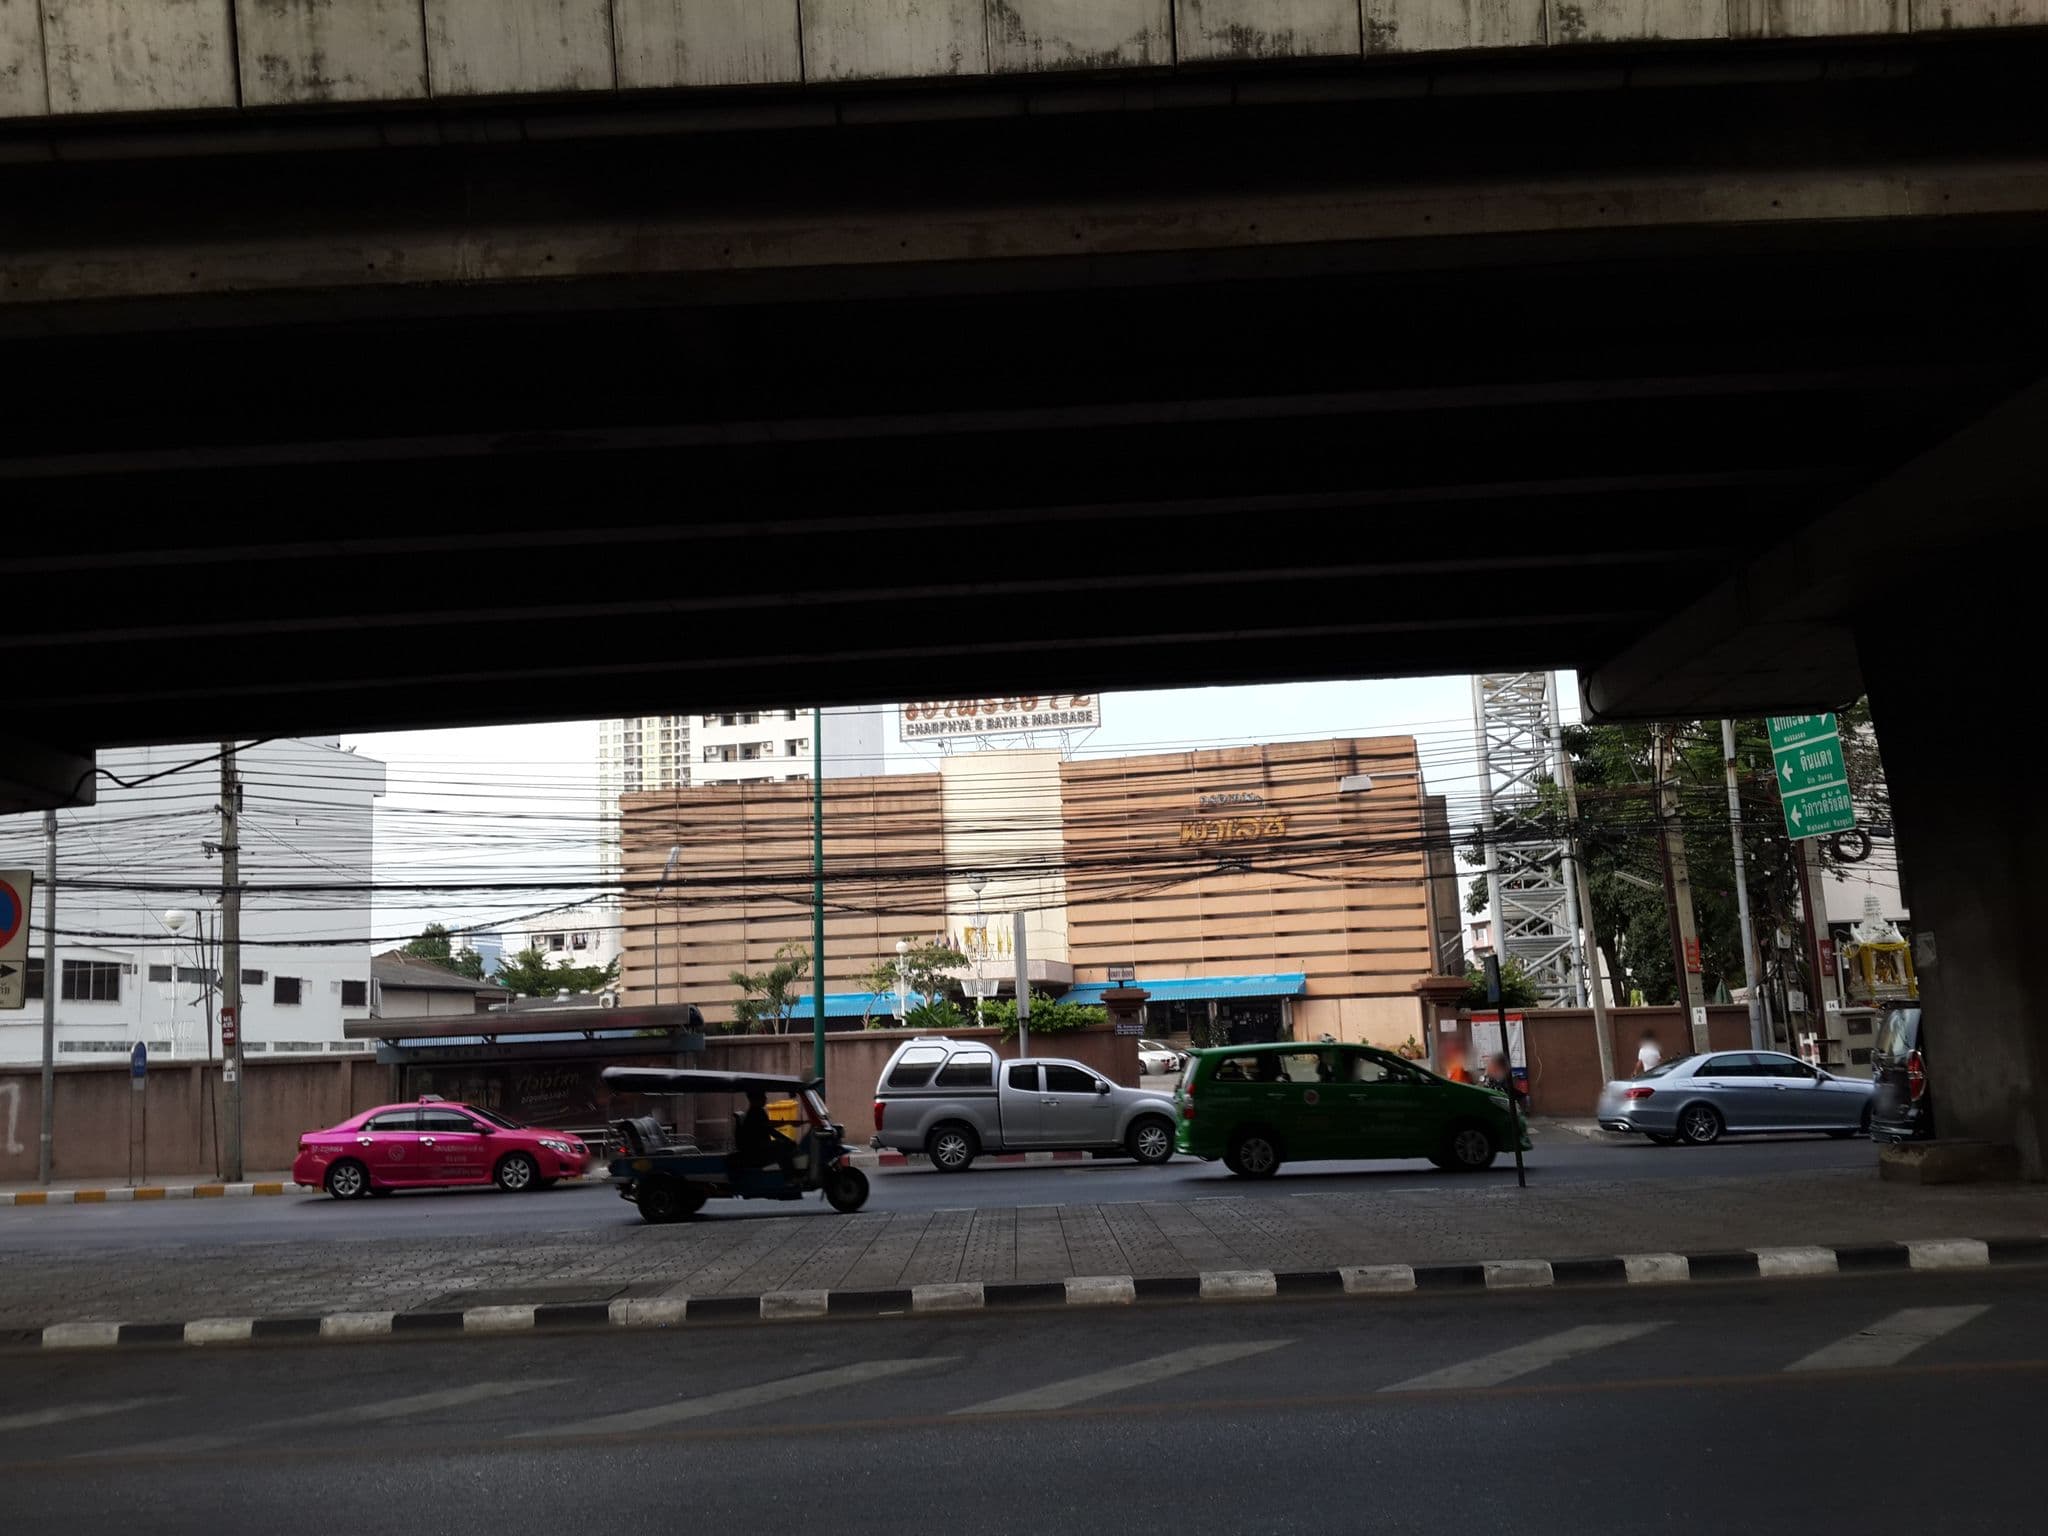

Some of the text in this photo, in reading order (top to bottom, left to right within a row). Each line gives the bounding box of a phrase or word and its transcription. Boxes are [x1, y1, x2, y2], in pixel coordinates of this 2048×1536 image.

[986, 715, 1017, 729] BATH
[1020, 715, 1028, 726] &
[1032, 710, 1093, 726] MASSAGE
[1799, 749, 1834, 772] ดินแดง
[1801, 789, 1850, 817] วิภาวดีรังสิต
